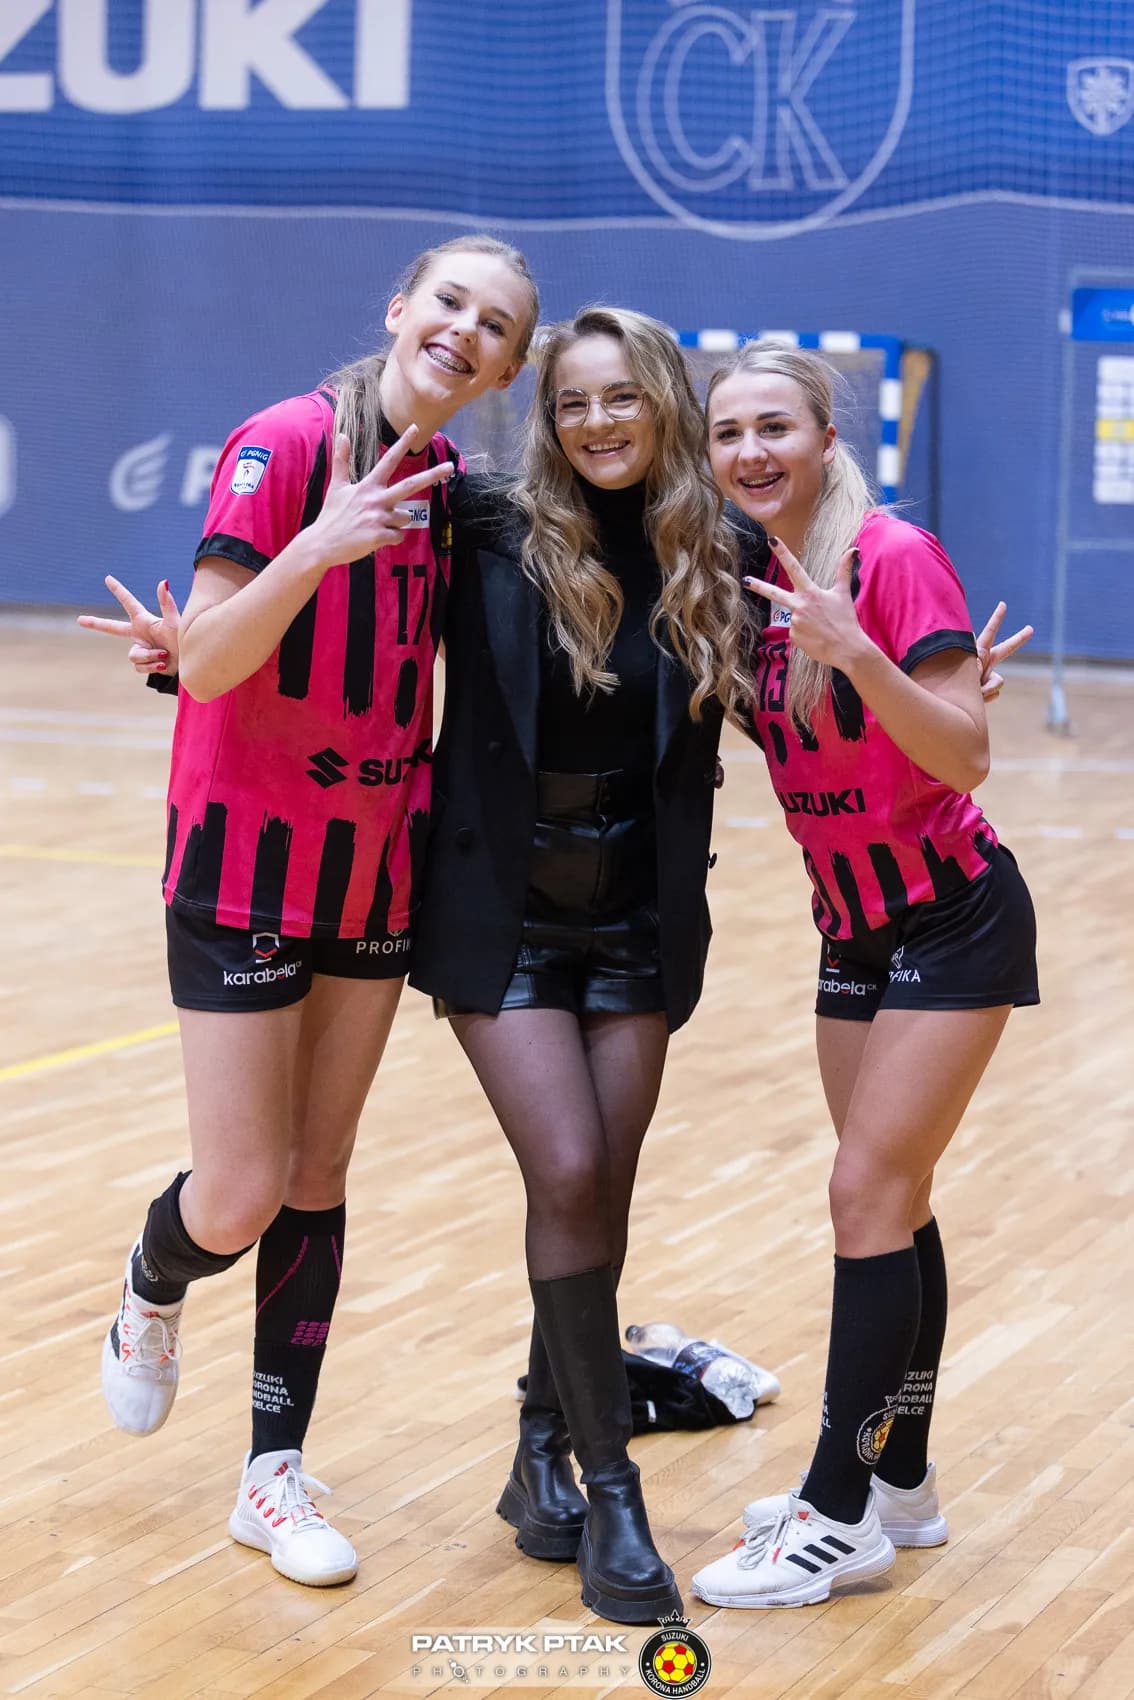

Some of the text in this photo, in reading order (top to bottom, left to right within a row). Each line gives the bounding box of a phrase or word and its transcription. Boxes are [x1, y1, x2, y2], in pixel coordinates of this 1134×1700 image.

[391, 564, 429, 645] 17
[779, 787, 866, 817] UZUKI
[223, 962, 297, 986] karabela
